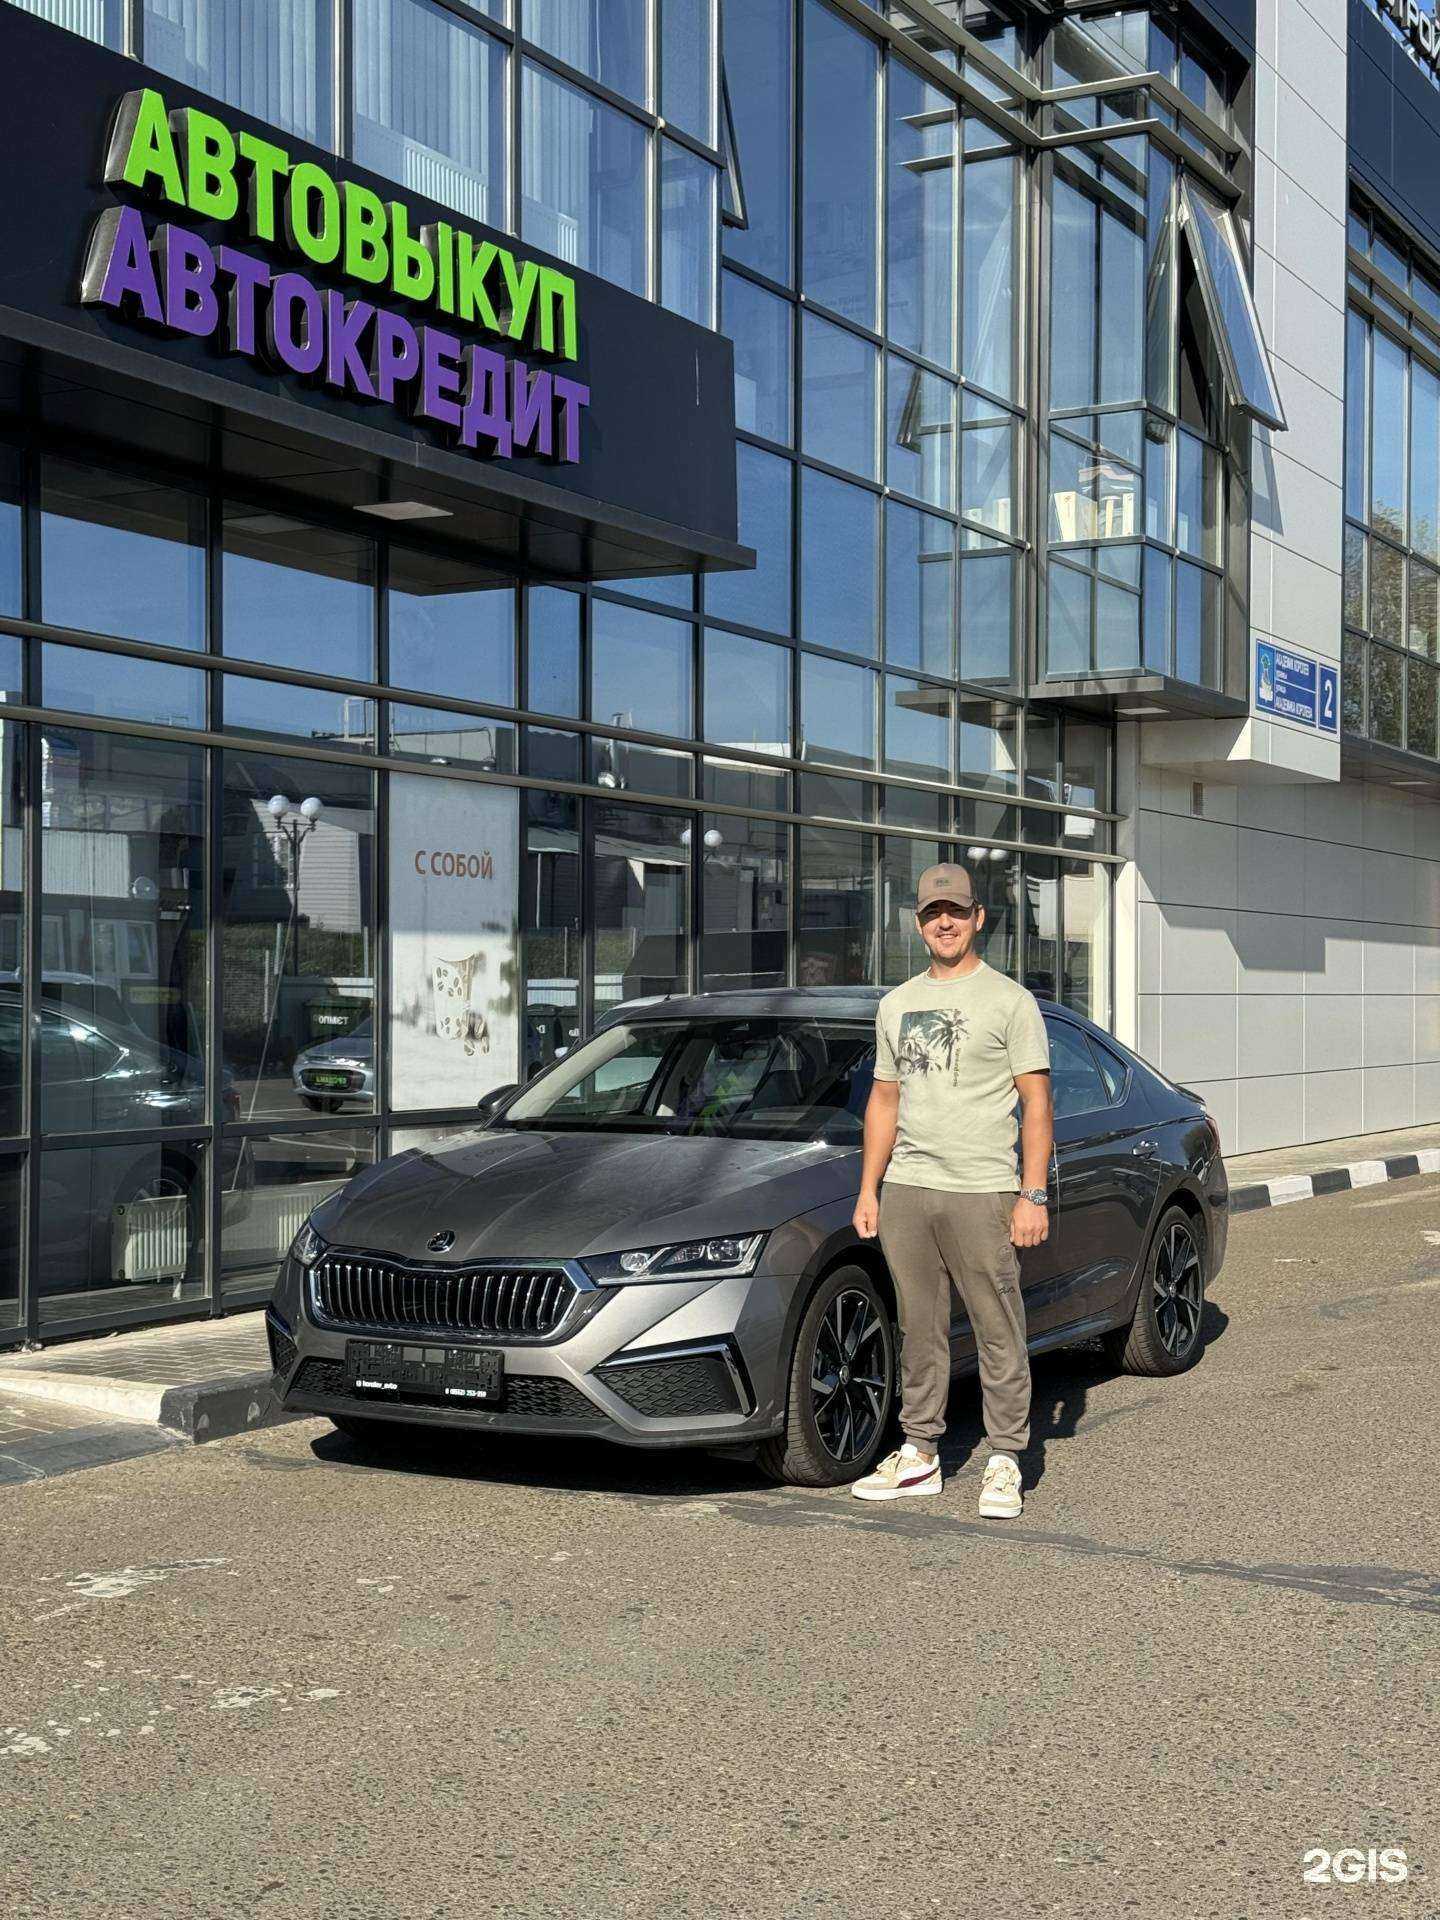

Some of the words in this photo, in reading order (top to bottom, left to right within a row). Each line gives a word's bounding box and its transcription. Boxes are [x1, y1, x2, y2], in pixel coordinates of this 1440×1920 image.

[124, 87, 577, 361] АВТОВЫКУП
[99, 205, 591, 464] АВТОКРЕДИТ
[1324, 679, 1333, 719] 2
[415, 850, 426, 875] С
[431, 850, 493, 880] СОБОЙ
